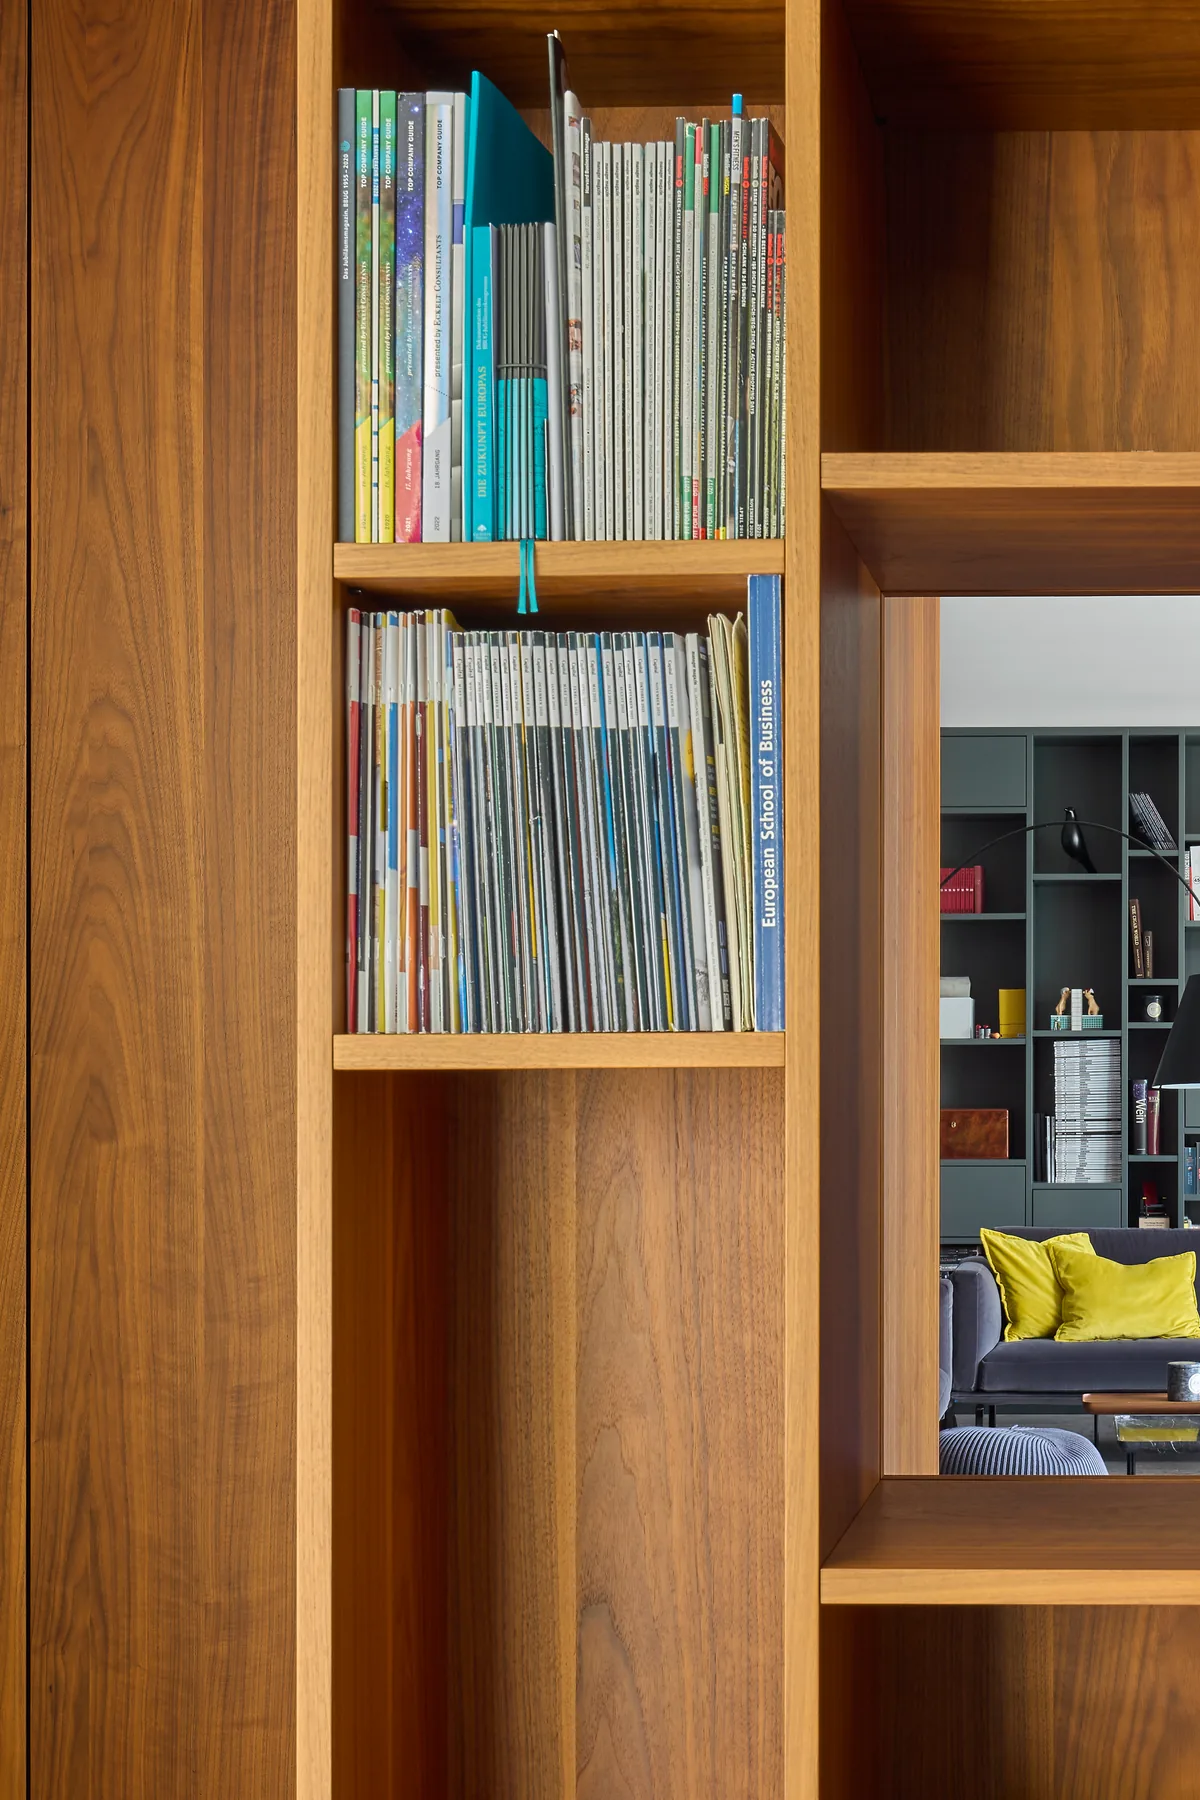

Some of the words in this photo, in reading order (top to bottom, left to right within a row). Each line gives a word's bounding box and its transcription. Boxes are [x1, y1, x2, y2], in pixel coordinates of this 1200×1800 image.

[732, 148, 740, 171] FITNESS
[434, 234, 442, 292] CONSULTANTS
[433, 339, 442, 378] presented
[477, 366, 487, 417] EUROPAS
[477, 420, 487, 476] ZUKUNFT
[477, 479, 487, 497] DIE
[758, 679, 773, 751] Business
[759, 759, 774, 777] of
[759, 785, 774, 840] School
[761, 848, 778, 928] European
[1136, 1098, 1146, 1124] Wein
